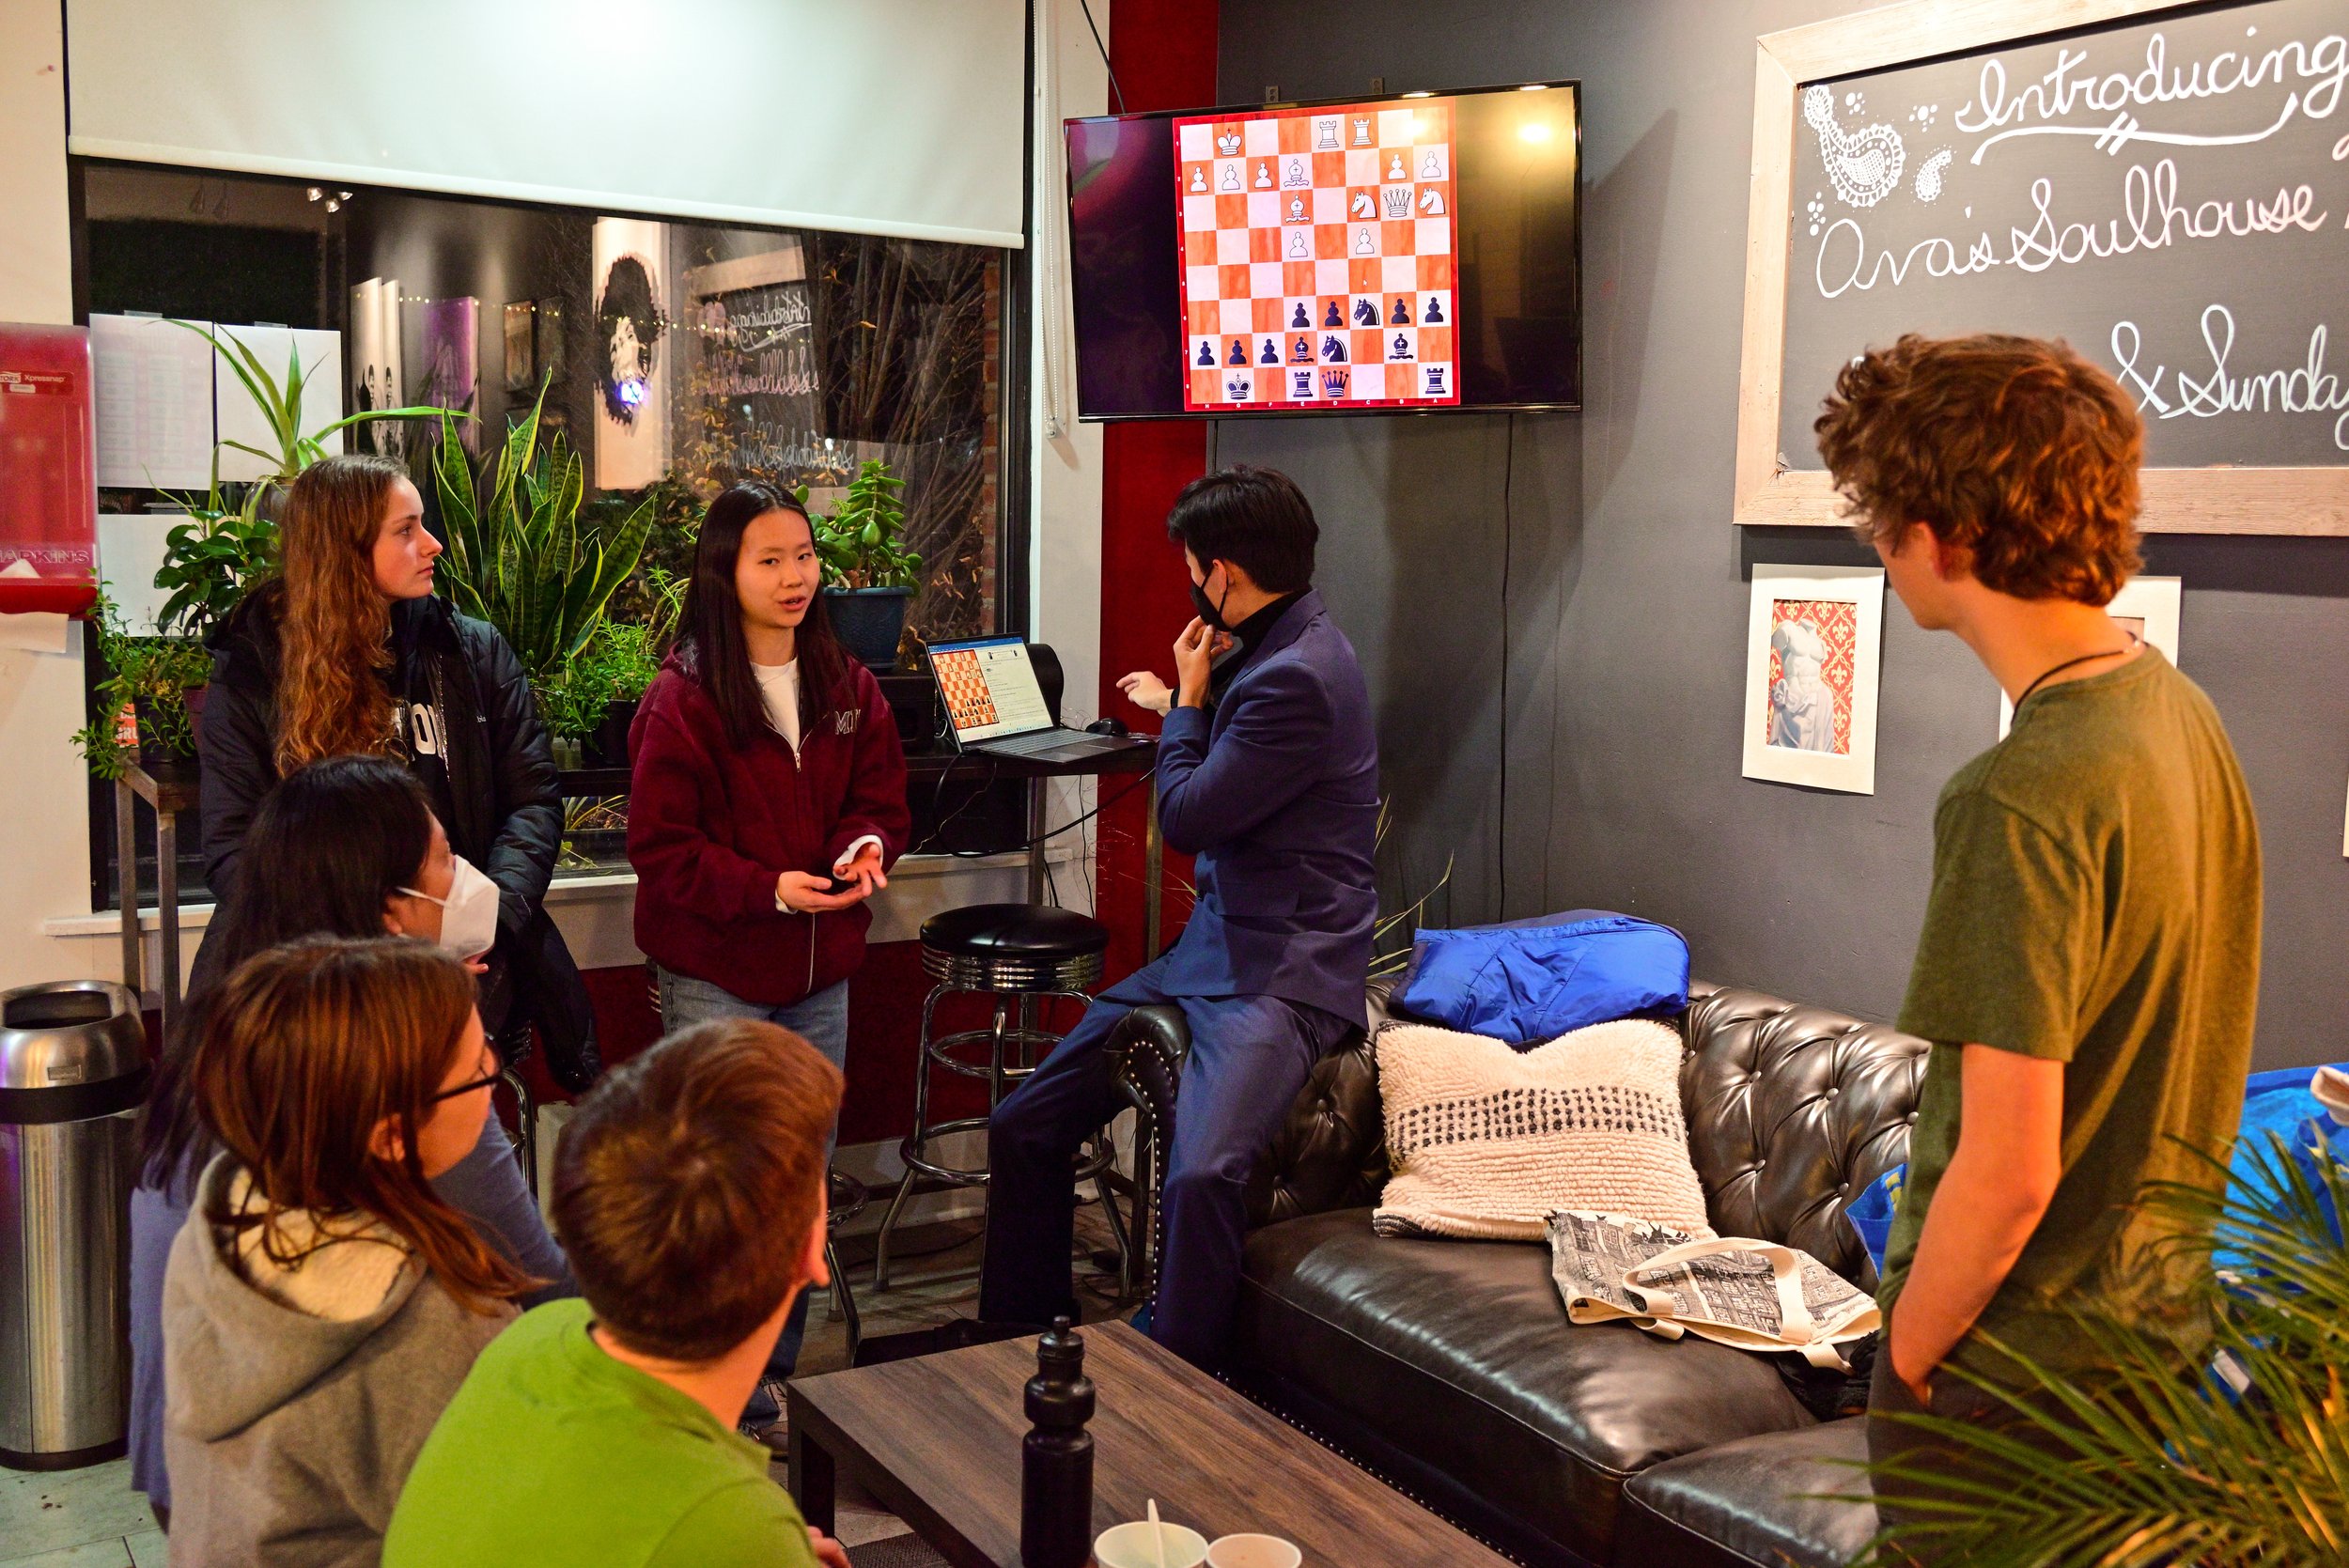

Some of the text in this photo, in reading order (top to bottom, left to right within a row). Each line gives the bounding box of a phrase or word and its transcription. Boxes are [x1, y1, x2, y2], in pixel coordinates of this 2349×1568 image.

[1954, 26, 2349, 132] Introducing
[2005, 159, 2327, 272] Soulhouse
[2110, 320, 2170, 413] &
